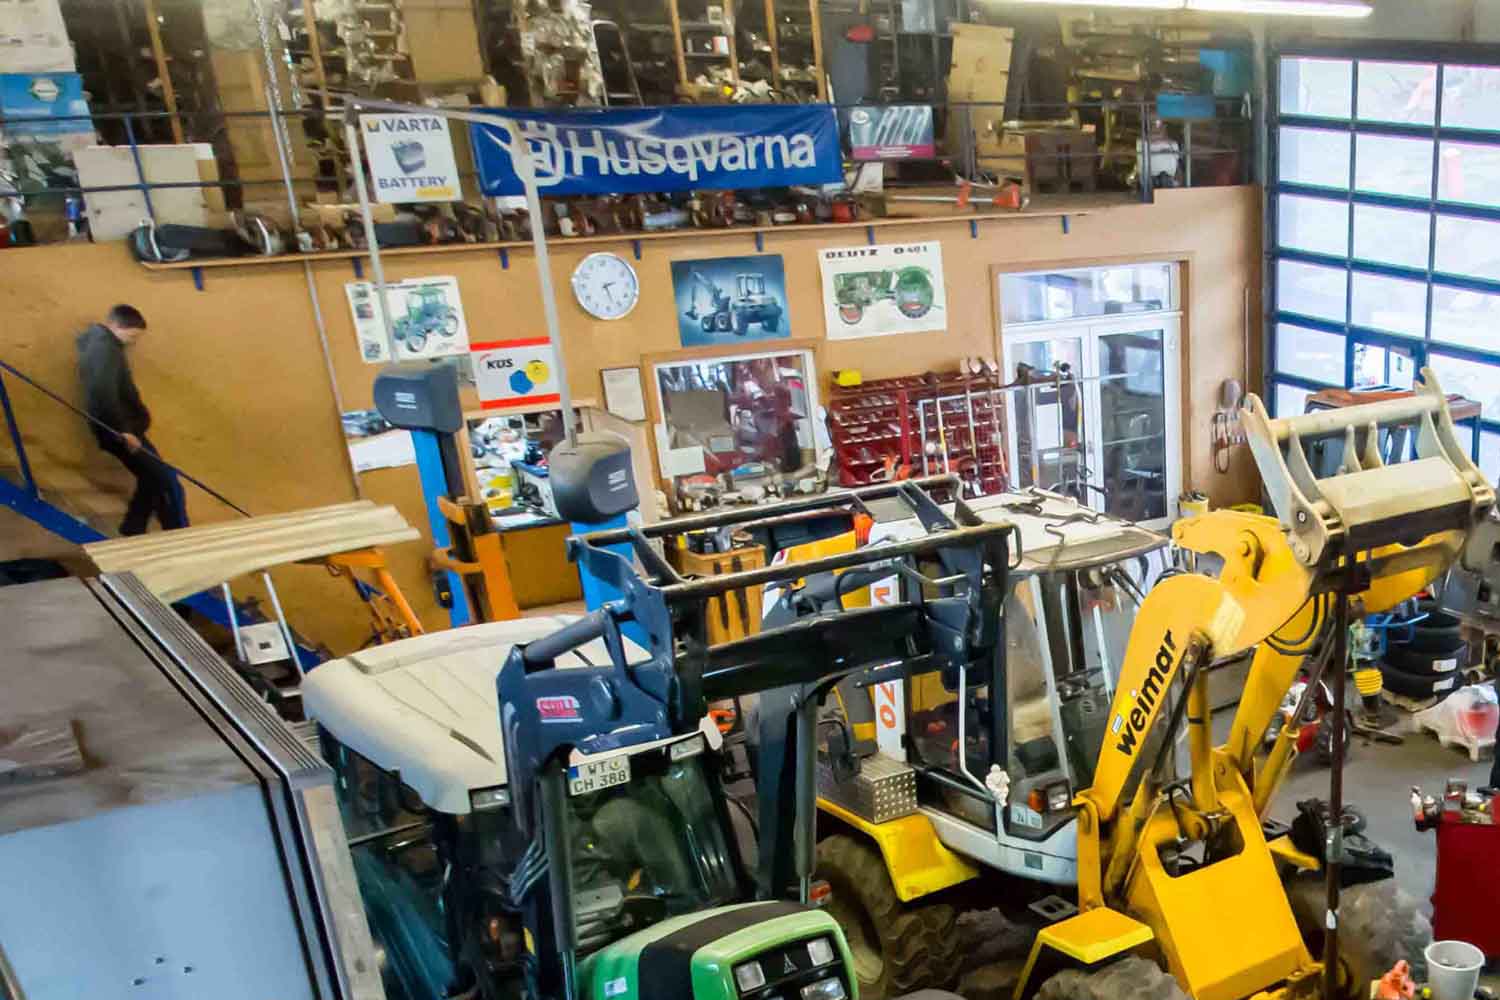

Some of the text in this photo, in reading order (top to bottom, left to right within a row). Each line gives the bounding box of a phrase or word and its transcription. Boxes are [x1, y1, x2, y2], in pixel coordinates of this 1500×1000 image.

[383, 118, 443, 133] VARTA
[565, 129, 817, 182] Husqvarna
[378, 176, 448, 190] BATTERY
[1115, 628, 1177, 757] weimar
[588, 761, 608, 776] WT
[573, 770, 627, 794] CH 388
